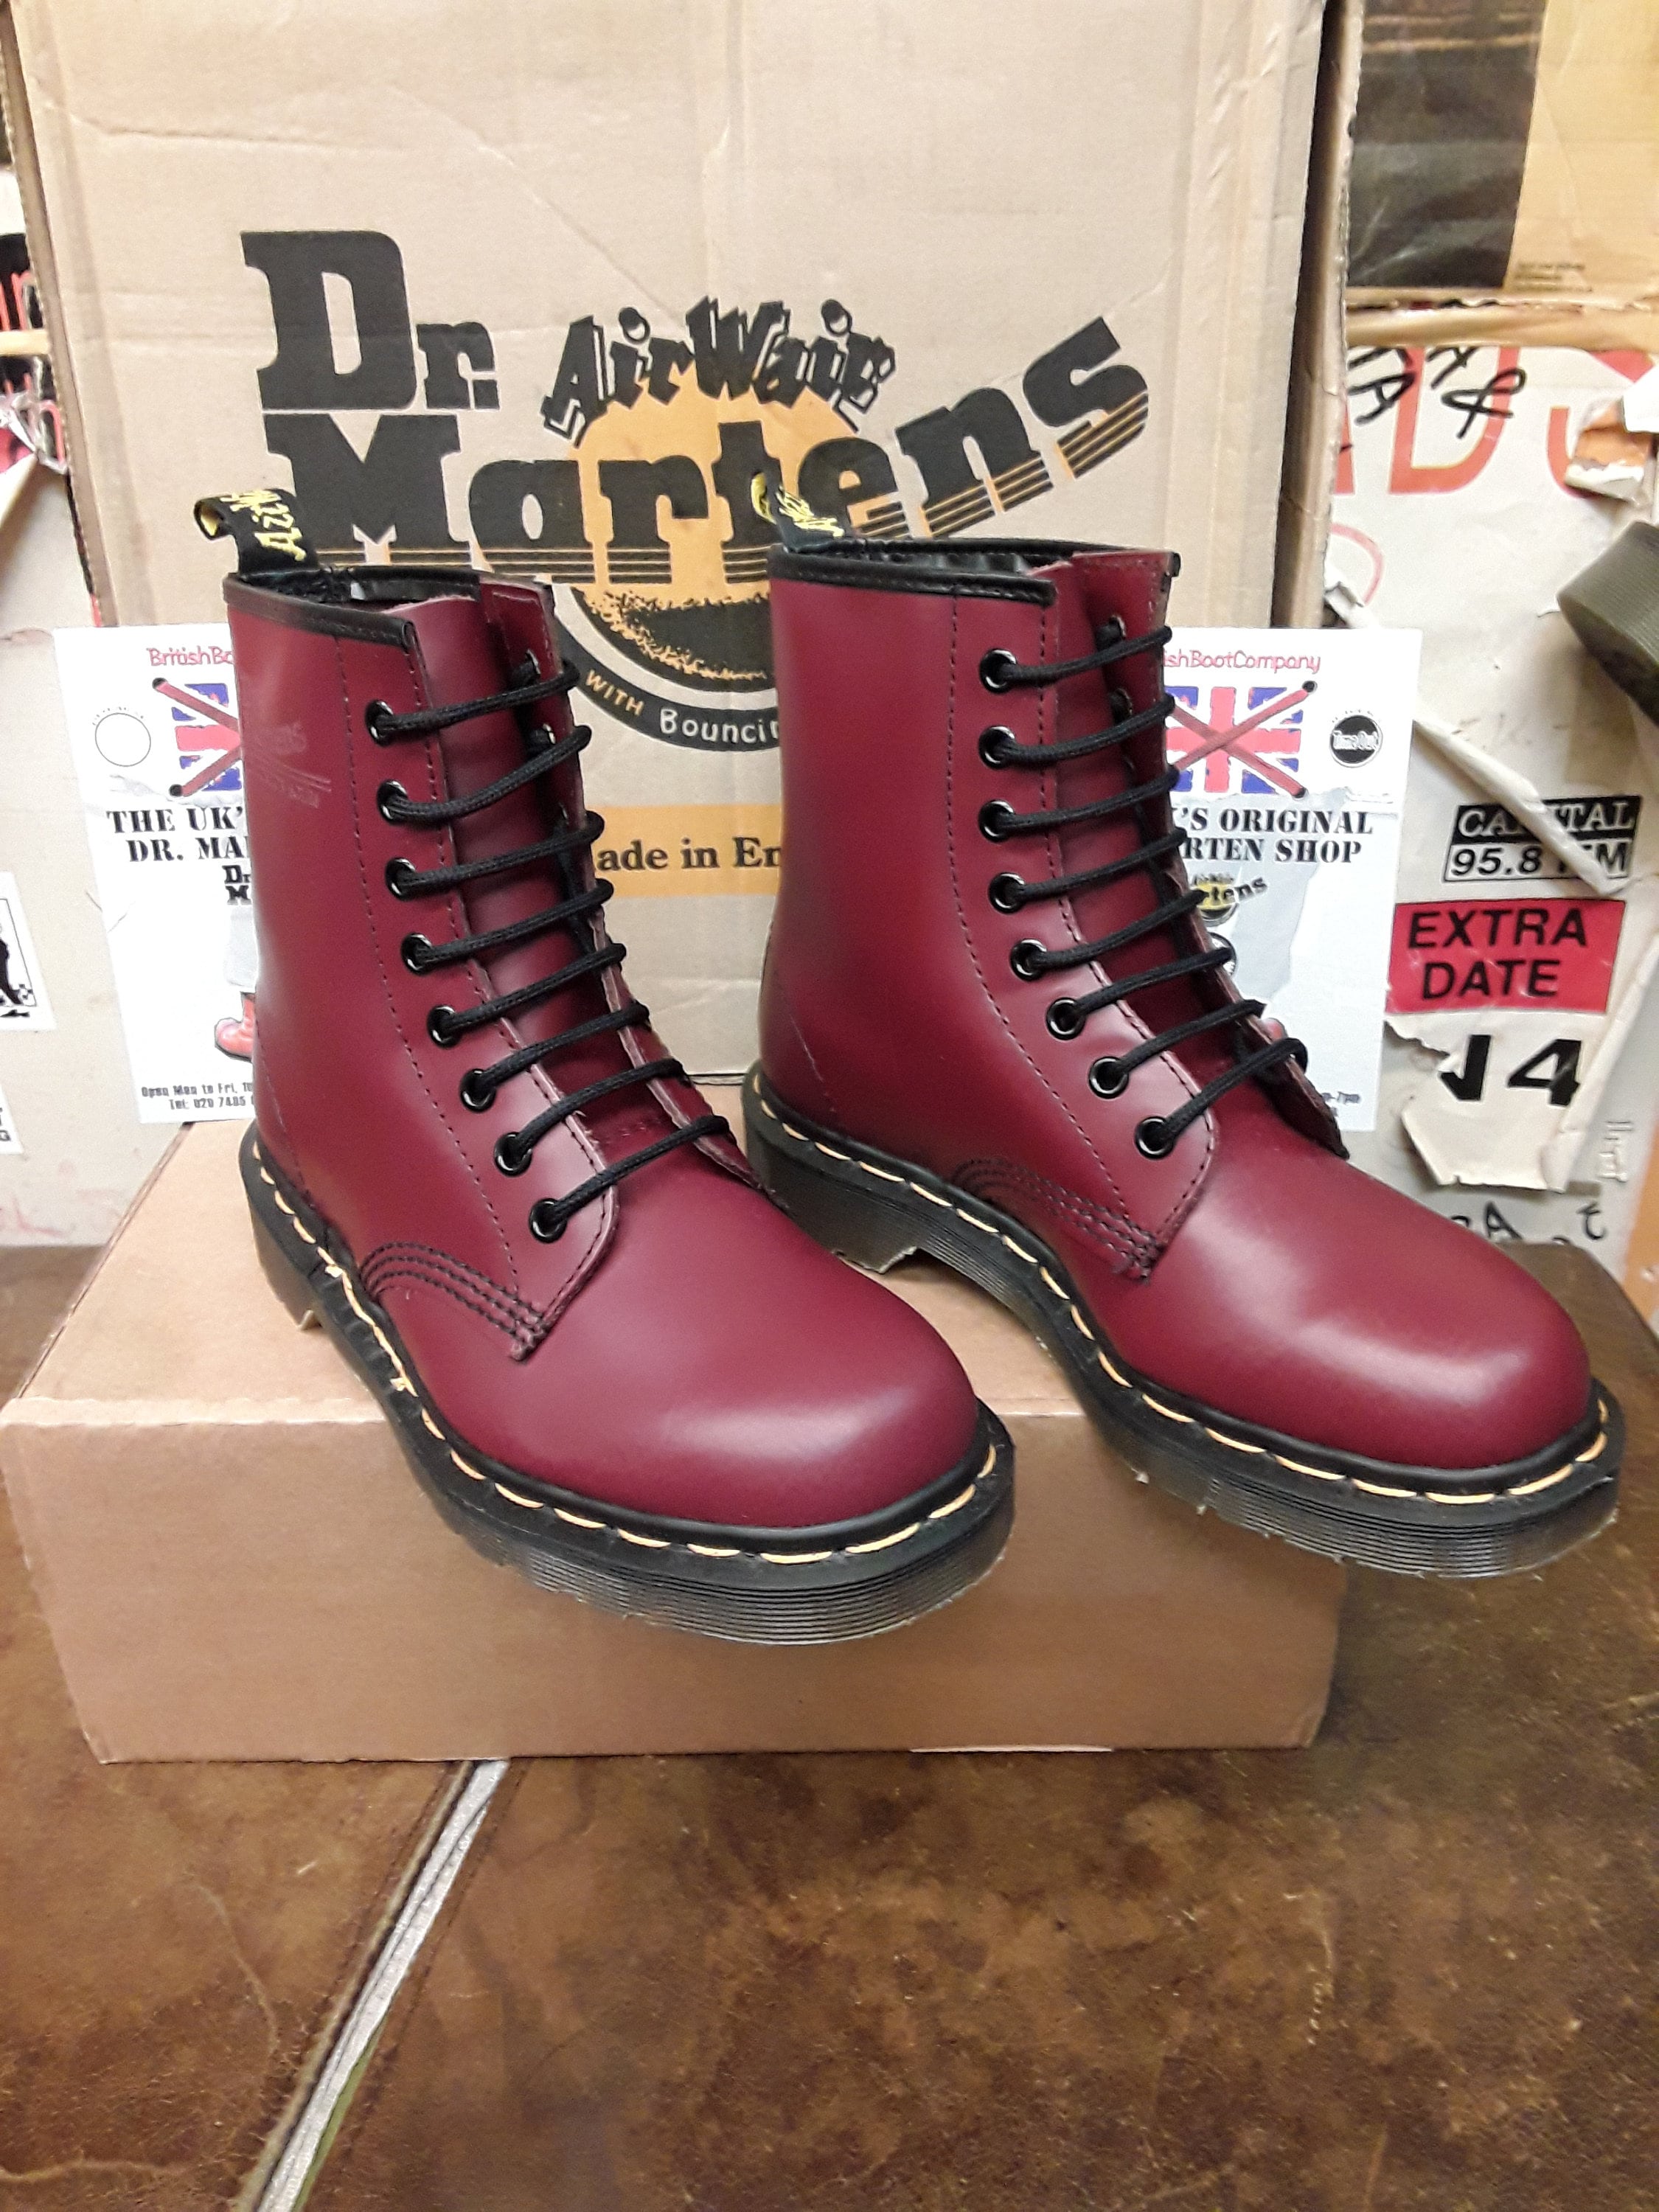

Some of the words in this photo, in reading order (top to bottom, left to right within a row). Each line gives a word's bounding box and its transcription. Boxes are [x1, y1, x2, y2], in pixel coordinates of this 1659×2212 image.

[540, 296, 895, 450] AirWair
[263, 317, 1149, 584] Martens
[585, 669, 644, 716] WITH
[106, 809, 175, 833] THE
[1172, 807, 1207, 830] 'S
[1219, 808, 1373, 834] ORIGINAL
[1458, 801, 1635, 838] CATAL
[126, 839, 184, 862] DR.
[195, 835, 249, 860] MA
[681, 838, 720, 869] in
[1274, 839, 1362, 863] SHOP
[1450, 845, 1543, 876] 95.8
[1408, 908, 1587, 949] EXTRA
[1422, 959, 1561, 1001] DATE
